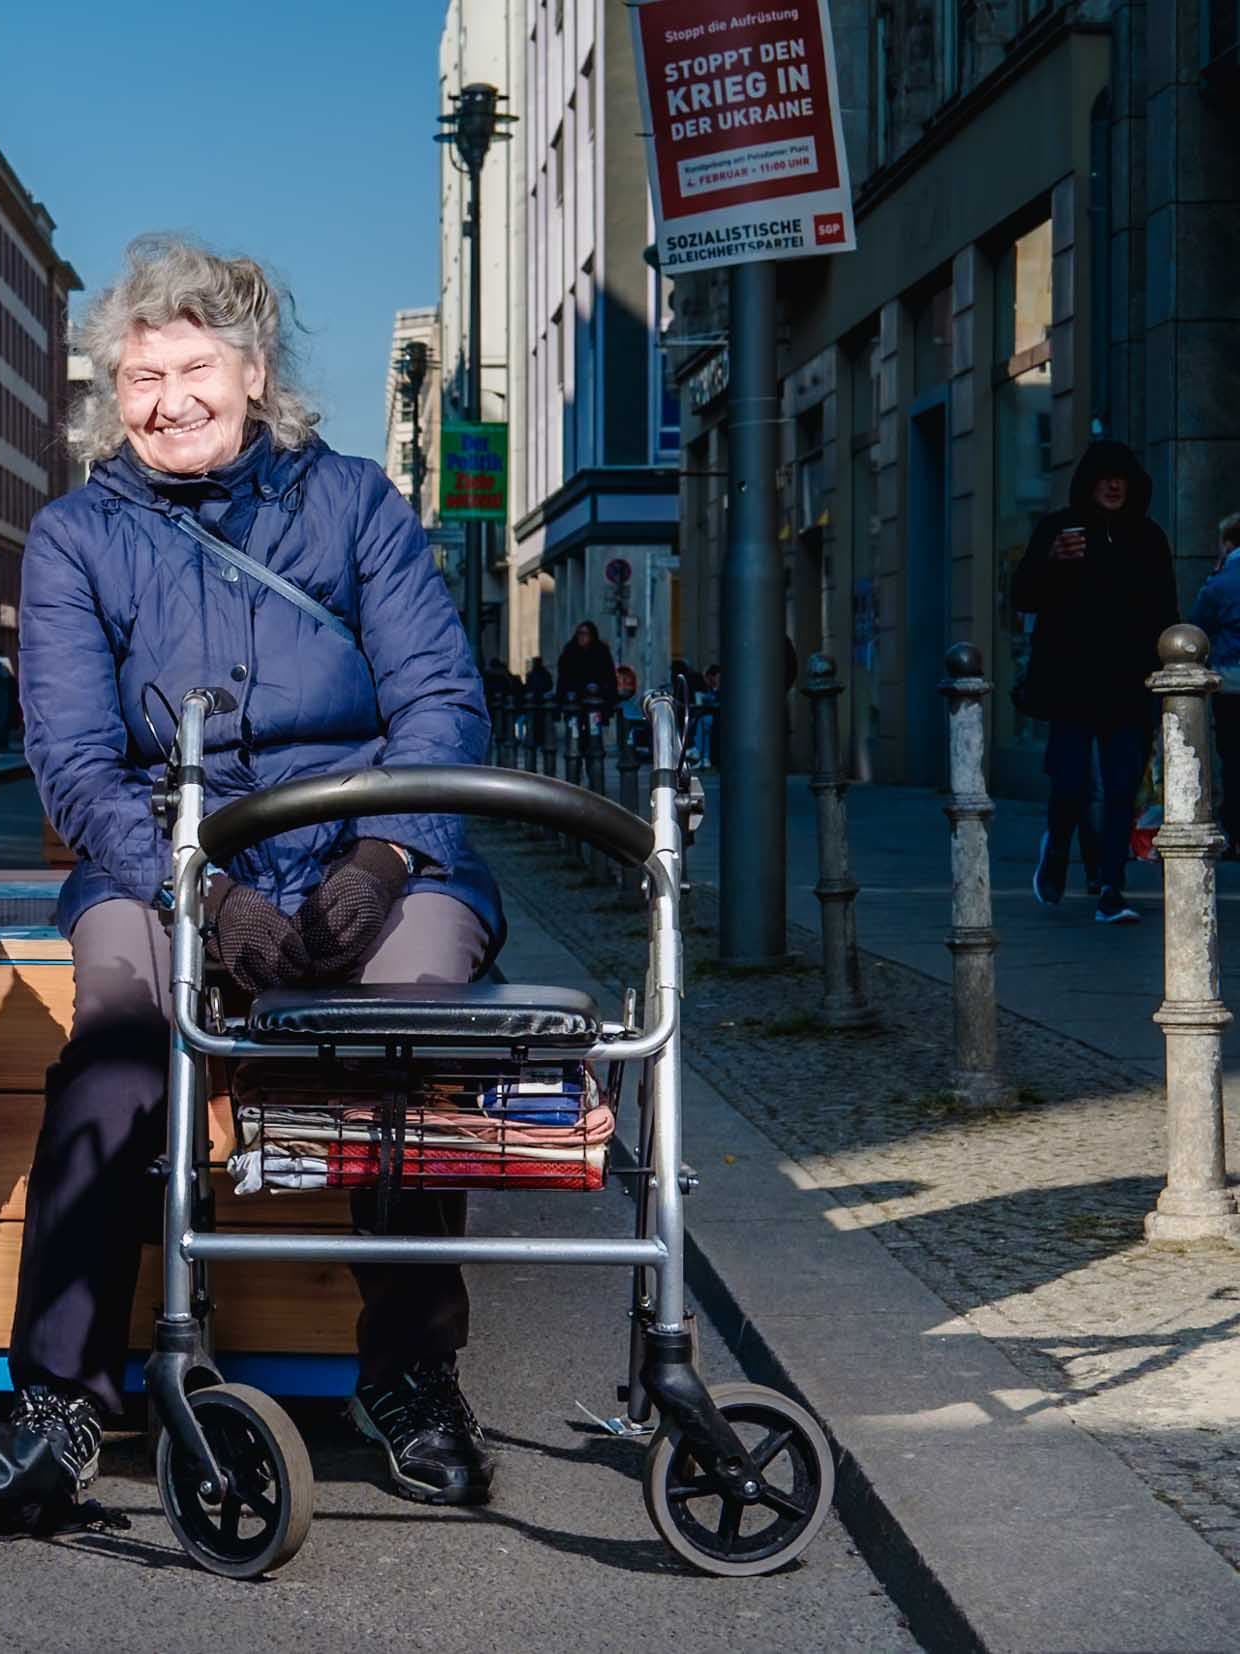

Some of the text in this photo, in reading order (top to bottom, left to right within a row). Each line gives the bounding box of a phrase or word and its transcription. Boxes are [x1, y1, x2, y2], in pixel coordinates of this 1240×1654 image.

[665, 8, 799, 43] Stoppt die Aufrüstung
[664, 38, 806, 82] STOPPT DEN
[666, 64, 810, 116] KRIEG IN
[671, 97, 814, 141] DER UKRAINE
[698, 167, 749, 185] FEBRUAR
[760, 161, 787, 174] 11:00
[788, 156, 810, 169] UHR
[666, 218, 802, 251] SOZIALISTISCHE
[818, 223, 841, 236] SGP
[668, 235, 804, 265] GLEICHHEITSPARTEI
